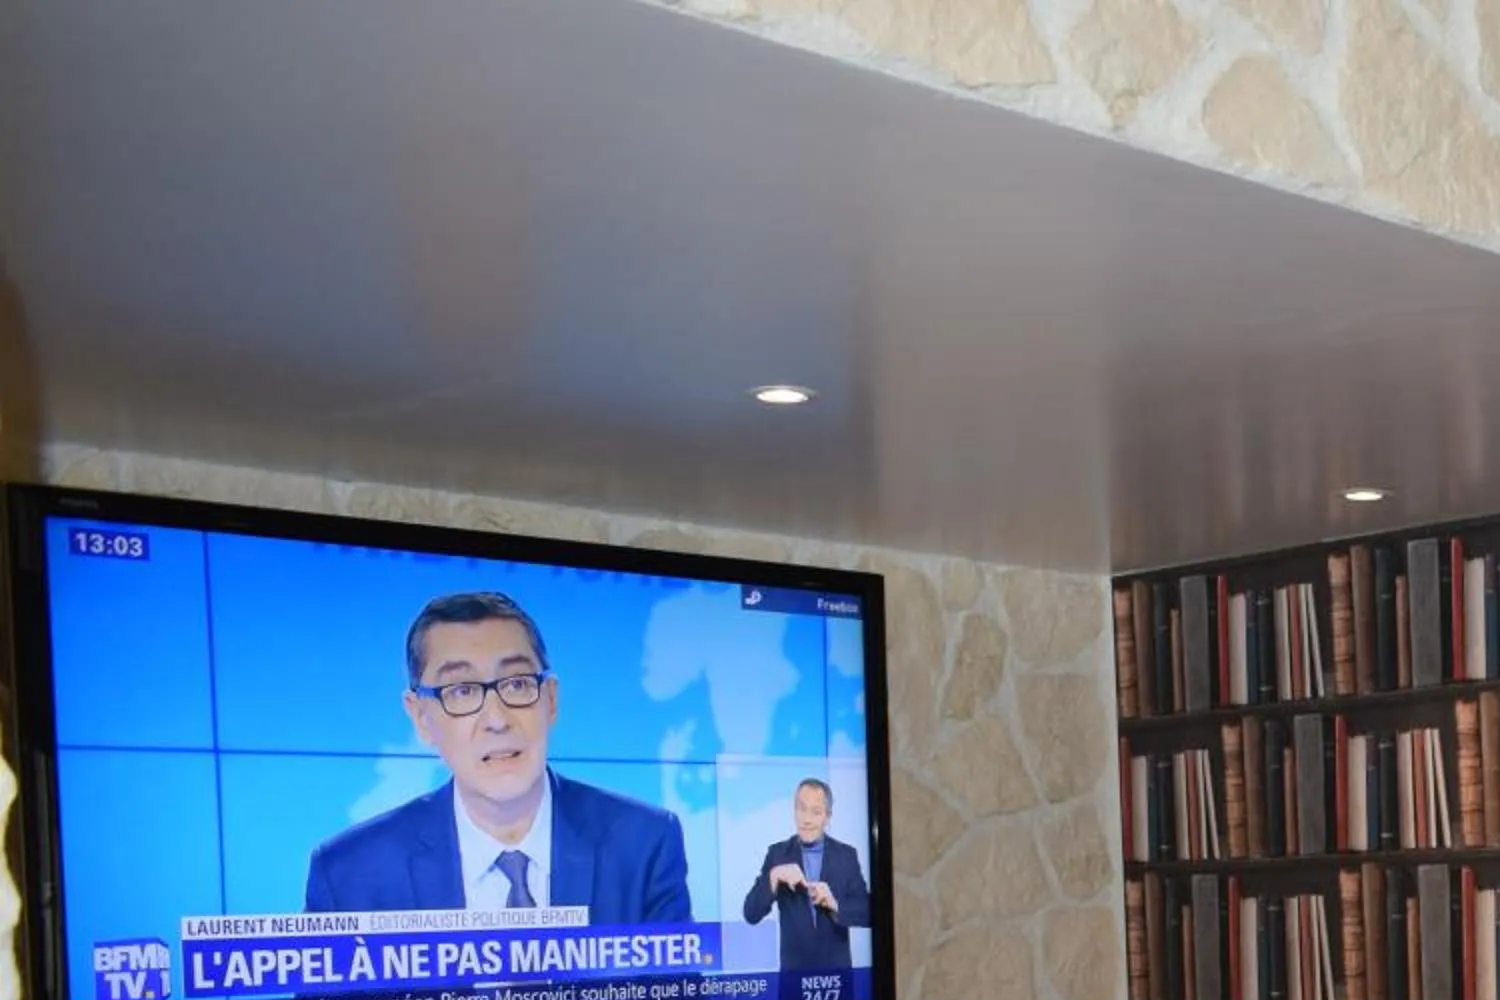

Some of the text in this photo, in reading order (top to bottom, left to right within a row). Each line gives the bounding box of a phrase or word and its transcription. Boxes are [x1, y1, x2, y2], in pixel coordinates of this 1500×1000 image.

[75, 532, 144, 557] 13:03
[187, 918, 266, 937] LAURENT
[271, 916, 359, 933] NEUMANN
[471, 910, 537, 927] POLITIQUE
[193, 947, 343, 989] L'APPEL
[349, 936, 377, 981] À
[383, 944, 430, 979] NE
[437, 940, 502, 975] PAS
[650, 983, 679, 1000] que
[683, 979, 697, 996] le
[701, 974, 767, 998] dérapage
[801, 975, 842, 989] NEWS
